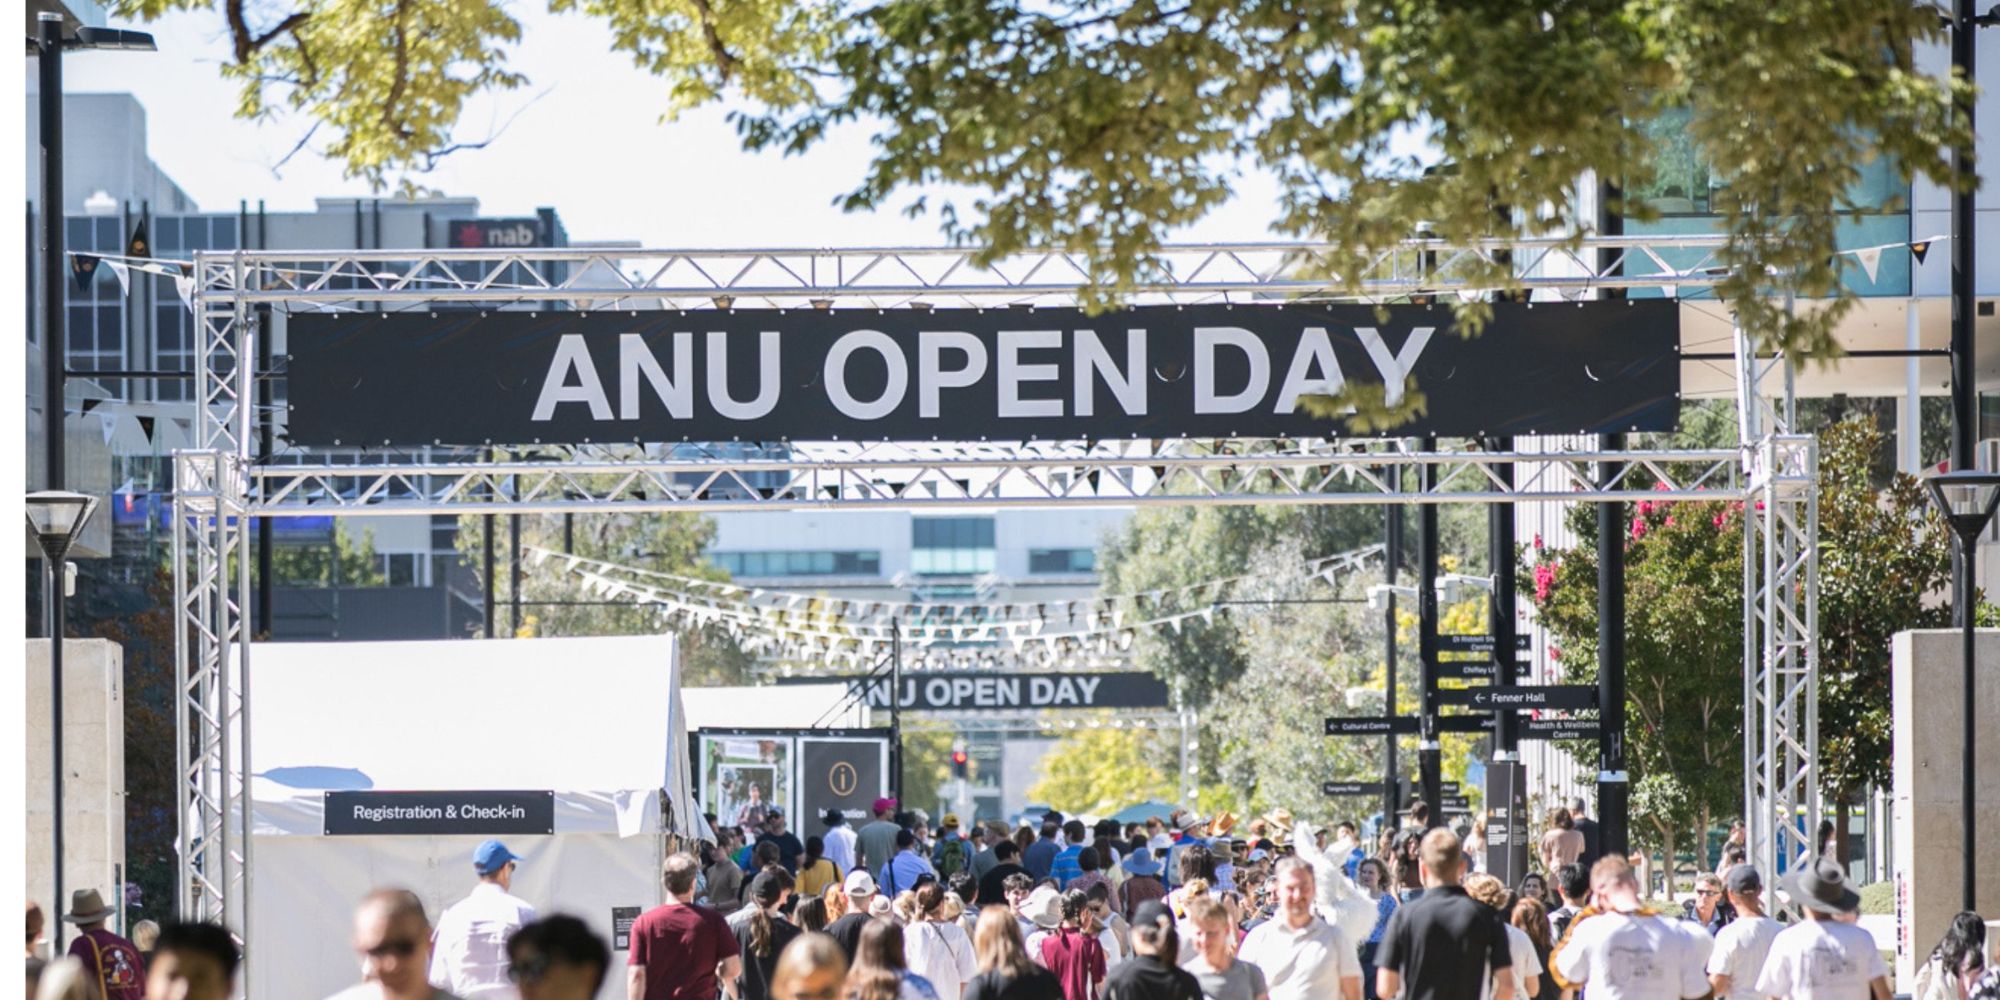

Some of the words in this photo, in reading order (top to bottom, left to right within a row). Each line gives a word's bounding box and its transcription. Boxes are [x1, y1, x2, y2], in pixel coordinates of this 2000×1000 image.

[488, 223, 534, 246] nab
[531, 331, 781, 421] ANU
[824, 328, 1148, 419] OPEN
[1195, 326, 1436, 416] DAY
[925, 678, 1021, 706] OPEN
[1030, 677, 1100, 704] DAY
[1491, 692, 1523, 703] Fenner
[1525, 692, 1545, 702] Hall
[1342, 722, 1368, 730] Cultural
[1369, 721, 1391, 730] Centre
[1529, 721, 1555, 730] Health
[1556, 721, 1563, 729] &
[1553, 730, 1579, 738] Centre
[353, 804, 442, 821] Registration
[445, 804, 457, 819] &
[460, 804, 525, 819] Check-in
